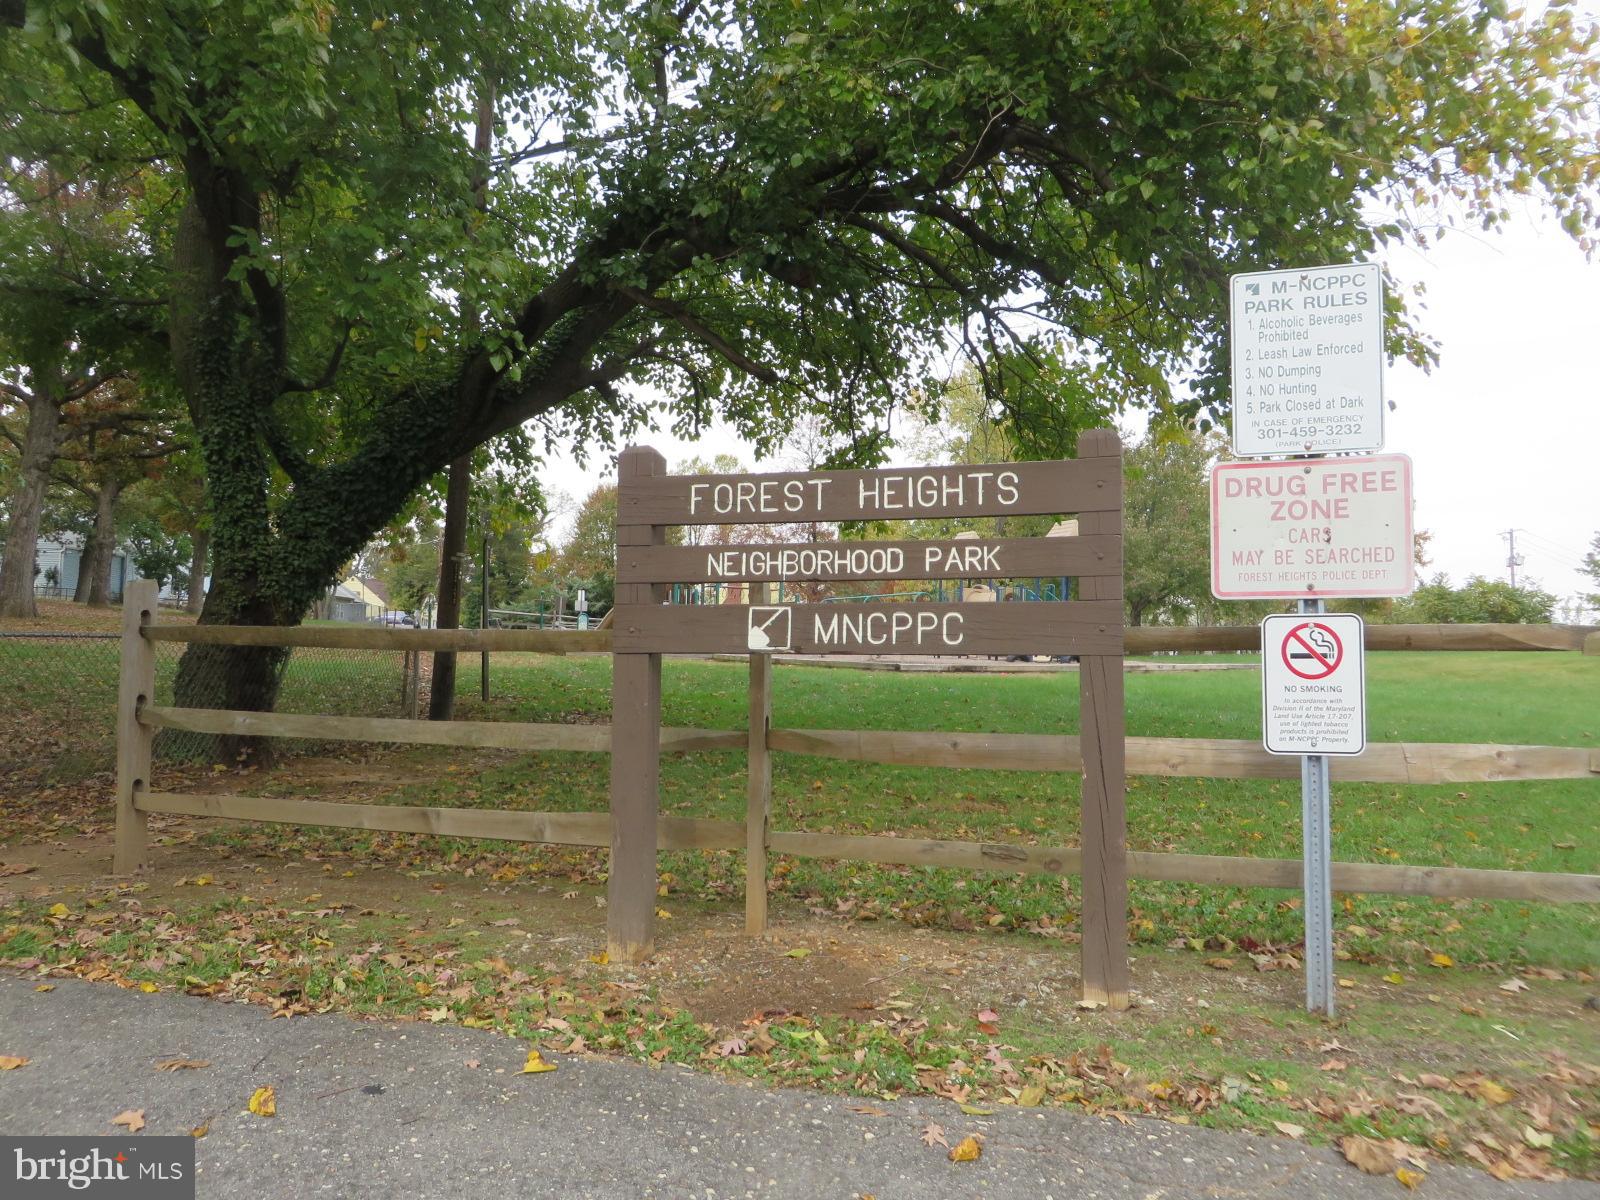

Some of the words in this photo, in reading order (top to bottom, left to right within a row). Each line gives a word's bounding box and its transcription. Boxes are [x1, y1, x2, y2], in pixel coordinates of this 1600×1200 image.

[1271, 273, 1366, 294] M-NCPPC
[1244, 298, 1294, 314] PARK
[1303, 291, 1368, 310] RULES
[1247, 320, 1255, 330] 1.
[1258, 315, 1305, 330] Alcoholic
[1309, 312, 1363, 327] Beverages
[1258, 329, 1309, 343] Prohibited
[1245, 348, 1254, 361] 2.
[1258, 347, 1288, 360] Leash
[1292, 346, 1312, 358] Law
[1316, 341, 1364, 356] Enforced
[1245, 367, 1254, 380] 3.
[1258, 366, 1274, 379] NO
[1277, 363, 1322, 378] Dumping
[1246, 385, 1256, 397] 4.
[1259, 383, 1275, 396] NO
[1279, 382, 1317, 396] Hunting
[1246, 402, 1256, 414] 5.
[1259, 401, 1282, 414] Park
[1285, 398, 1321, 412] Closed
[1325, 398, 1336, 410] at
[1340, 396, 1364, 409] Dark
[1251, 420, 1261, 428] IN
[1264, 419, 1288, 427] CASE
[1291, 417, 1304, 425] OF
[1307, 414, 1364, 425] EMERGENCY
[1257, 423, 1362, 440] 301-459-3232
[1306, 438, 1341, 447] OLICE)
[689, 478, 833, 515] FOREST
[858, 471, 1020, 509] HEIGHTS
[1225, 474, 1306, 498] DRUG
[1322, 470, 1397, 494] FREE
[1270, 498, 1350, 521] ZONE
[1288, 527, 1332, 544] CARS
[707, 547, 905, 578] NEIGHBORHOOD
[925, 545, 1002, 573] PARK
[1232, 550, 1264, 566] MAY
[1274, 549, 1294, 565] BE
[1304, 546, 1395, 564] SEARCHED
[1238, 571, 1273, 582] FOREST
[1278, 570, 1317, 581] HEIGHTS
[1322, 570, 1355, 581] POLICE
[1362, 569, 1388, 580] DEPT
[813, 611, 965, 647] MNCPPC
[1284, 685, 1297, 693] NO
[1300, 685, 1343, 693] SMOKING
[1300, 720, 1322, 728] lighted
